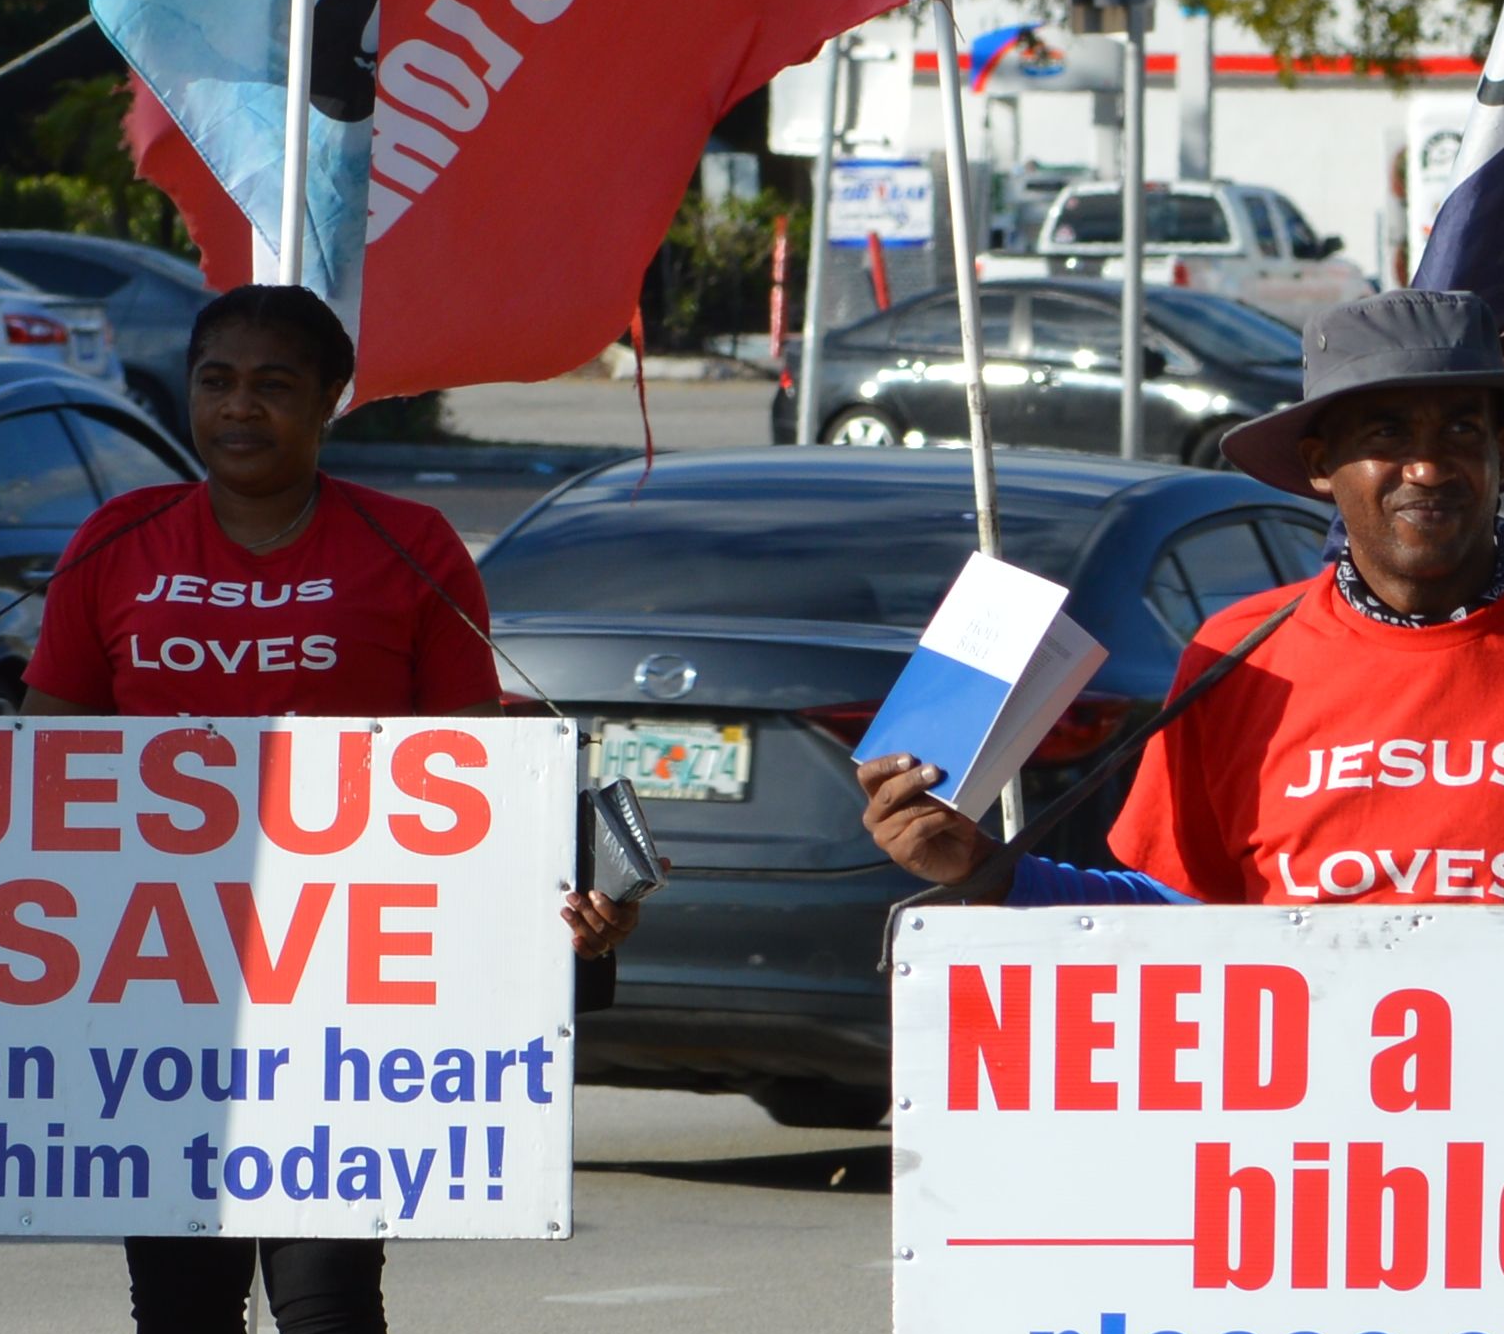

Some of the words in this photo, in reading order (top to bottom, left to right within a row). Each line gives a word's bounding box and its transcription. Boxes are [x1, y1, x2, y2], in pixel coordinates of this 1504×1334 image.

[138, 576, 333, 608] JESUS
[132, 636, 337, 674] LOVES
[91, 1048, 288, 1119] your
[327, 1029, 552, 1103] heart
[949, 966, 1310, 1112] NEED
[1372, 990, 1453, 1113] a
[185, 1127, 504, 1219] today!!
